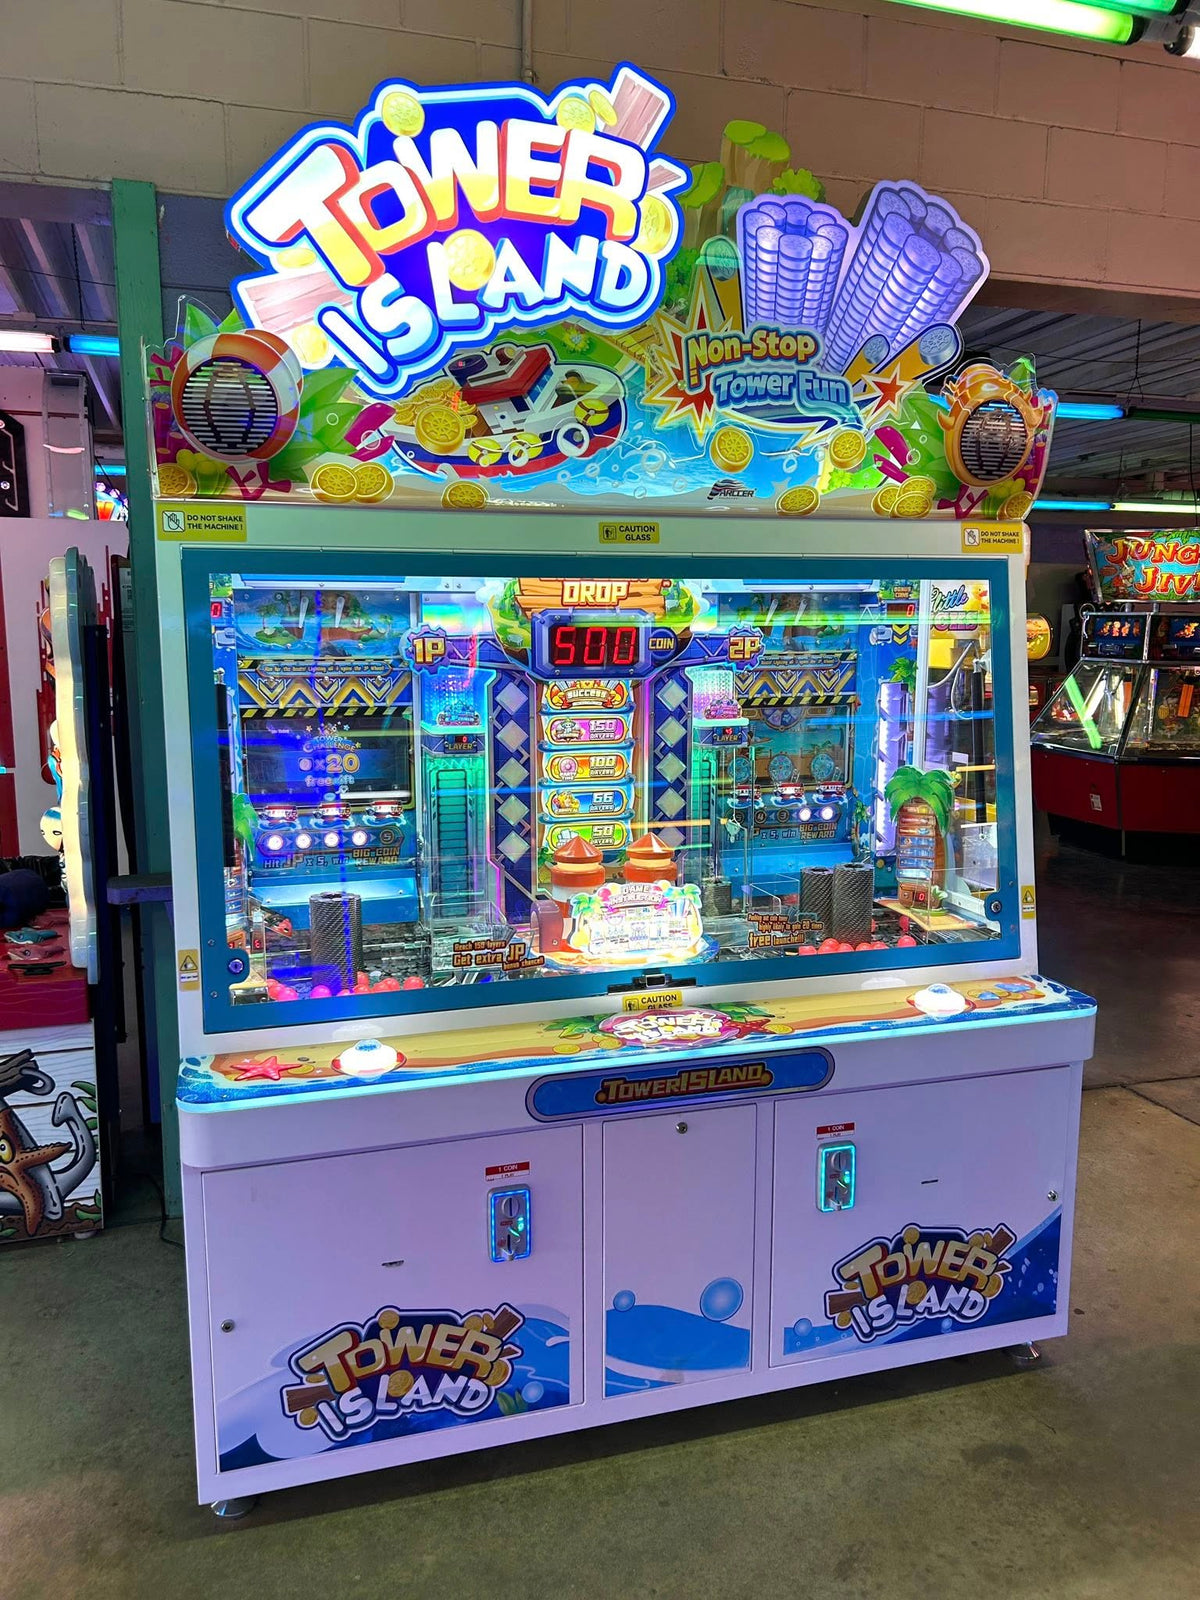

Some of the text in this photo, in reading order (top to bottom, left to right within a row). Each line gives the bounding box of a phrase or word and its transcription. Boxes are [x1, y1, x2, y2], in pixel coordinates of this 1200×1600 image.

[246, 119, 646, 287] TOWER
[320, 233, 650, 382] ISLAND
[687, 329, 816, 370] Non-Stop
[715, 371, 847, 404] Tower Fun
[204, 523, 239, 531] MACHINE
[618, 525, 656, 533] CAUTION
[625, 534, 651, 542] GLASS
[562, 580, 630, 604] DROP
[413, 637, 446, 663] 1P
[554, 626, 638, 665] 500
[648, 637, 675, 650] COIN
[729, 636, 761, 659] 2P
[589, 756, 616, 768] 100
[799, 823, 813, 832] BIG
[800, 830, 835, 839] REWARD
[353, 849, 371, 858] BIG
[355, 856, 398, 867] REWARD
[749, 933, 771, 947] free
[453, 943, 525, 966] Get extra JP
[641, 994, 677, 1004] CAUTION
[503, 1164, 518, 1172] COIN
[839, 1239, 999, 1300] TOWER
[852, 1283, 988, 1335] ISLAND
[299, 1323, 503, 1393] TOWER
[318, 1372, 489, 1433] ISLAND
